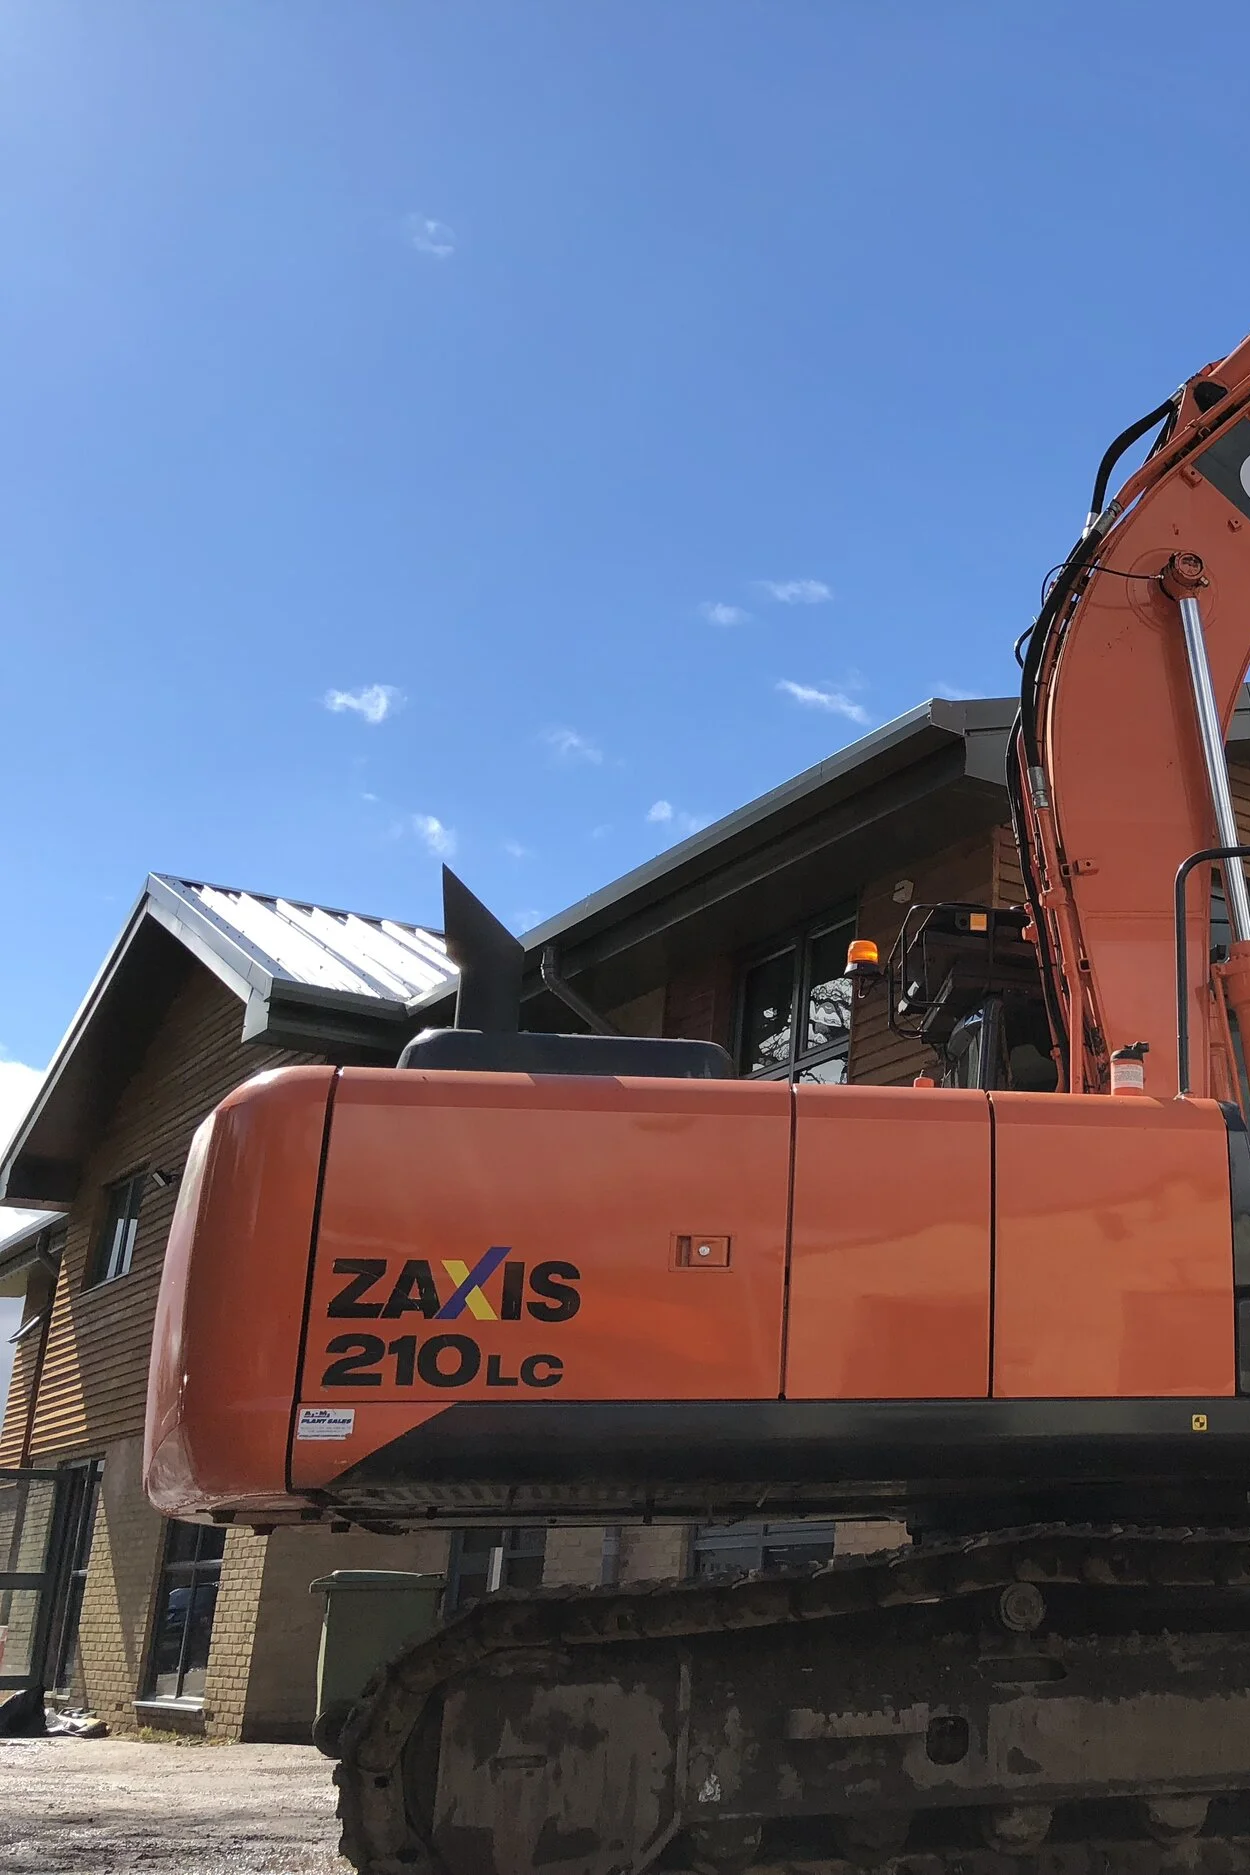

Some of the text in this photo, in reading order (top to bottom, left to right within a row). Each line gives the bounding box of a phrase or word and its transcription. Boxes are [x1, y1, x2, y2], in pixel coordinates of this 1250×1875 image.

[327, 1246, 581, 1322] ZAXIS
[321, 1333, 564, 1388] 210 LC
